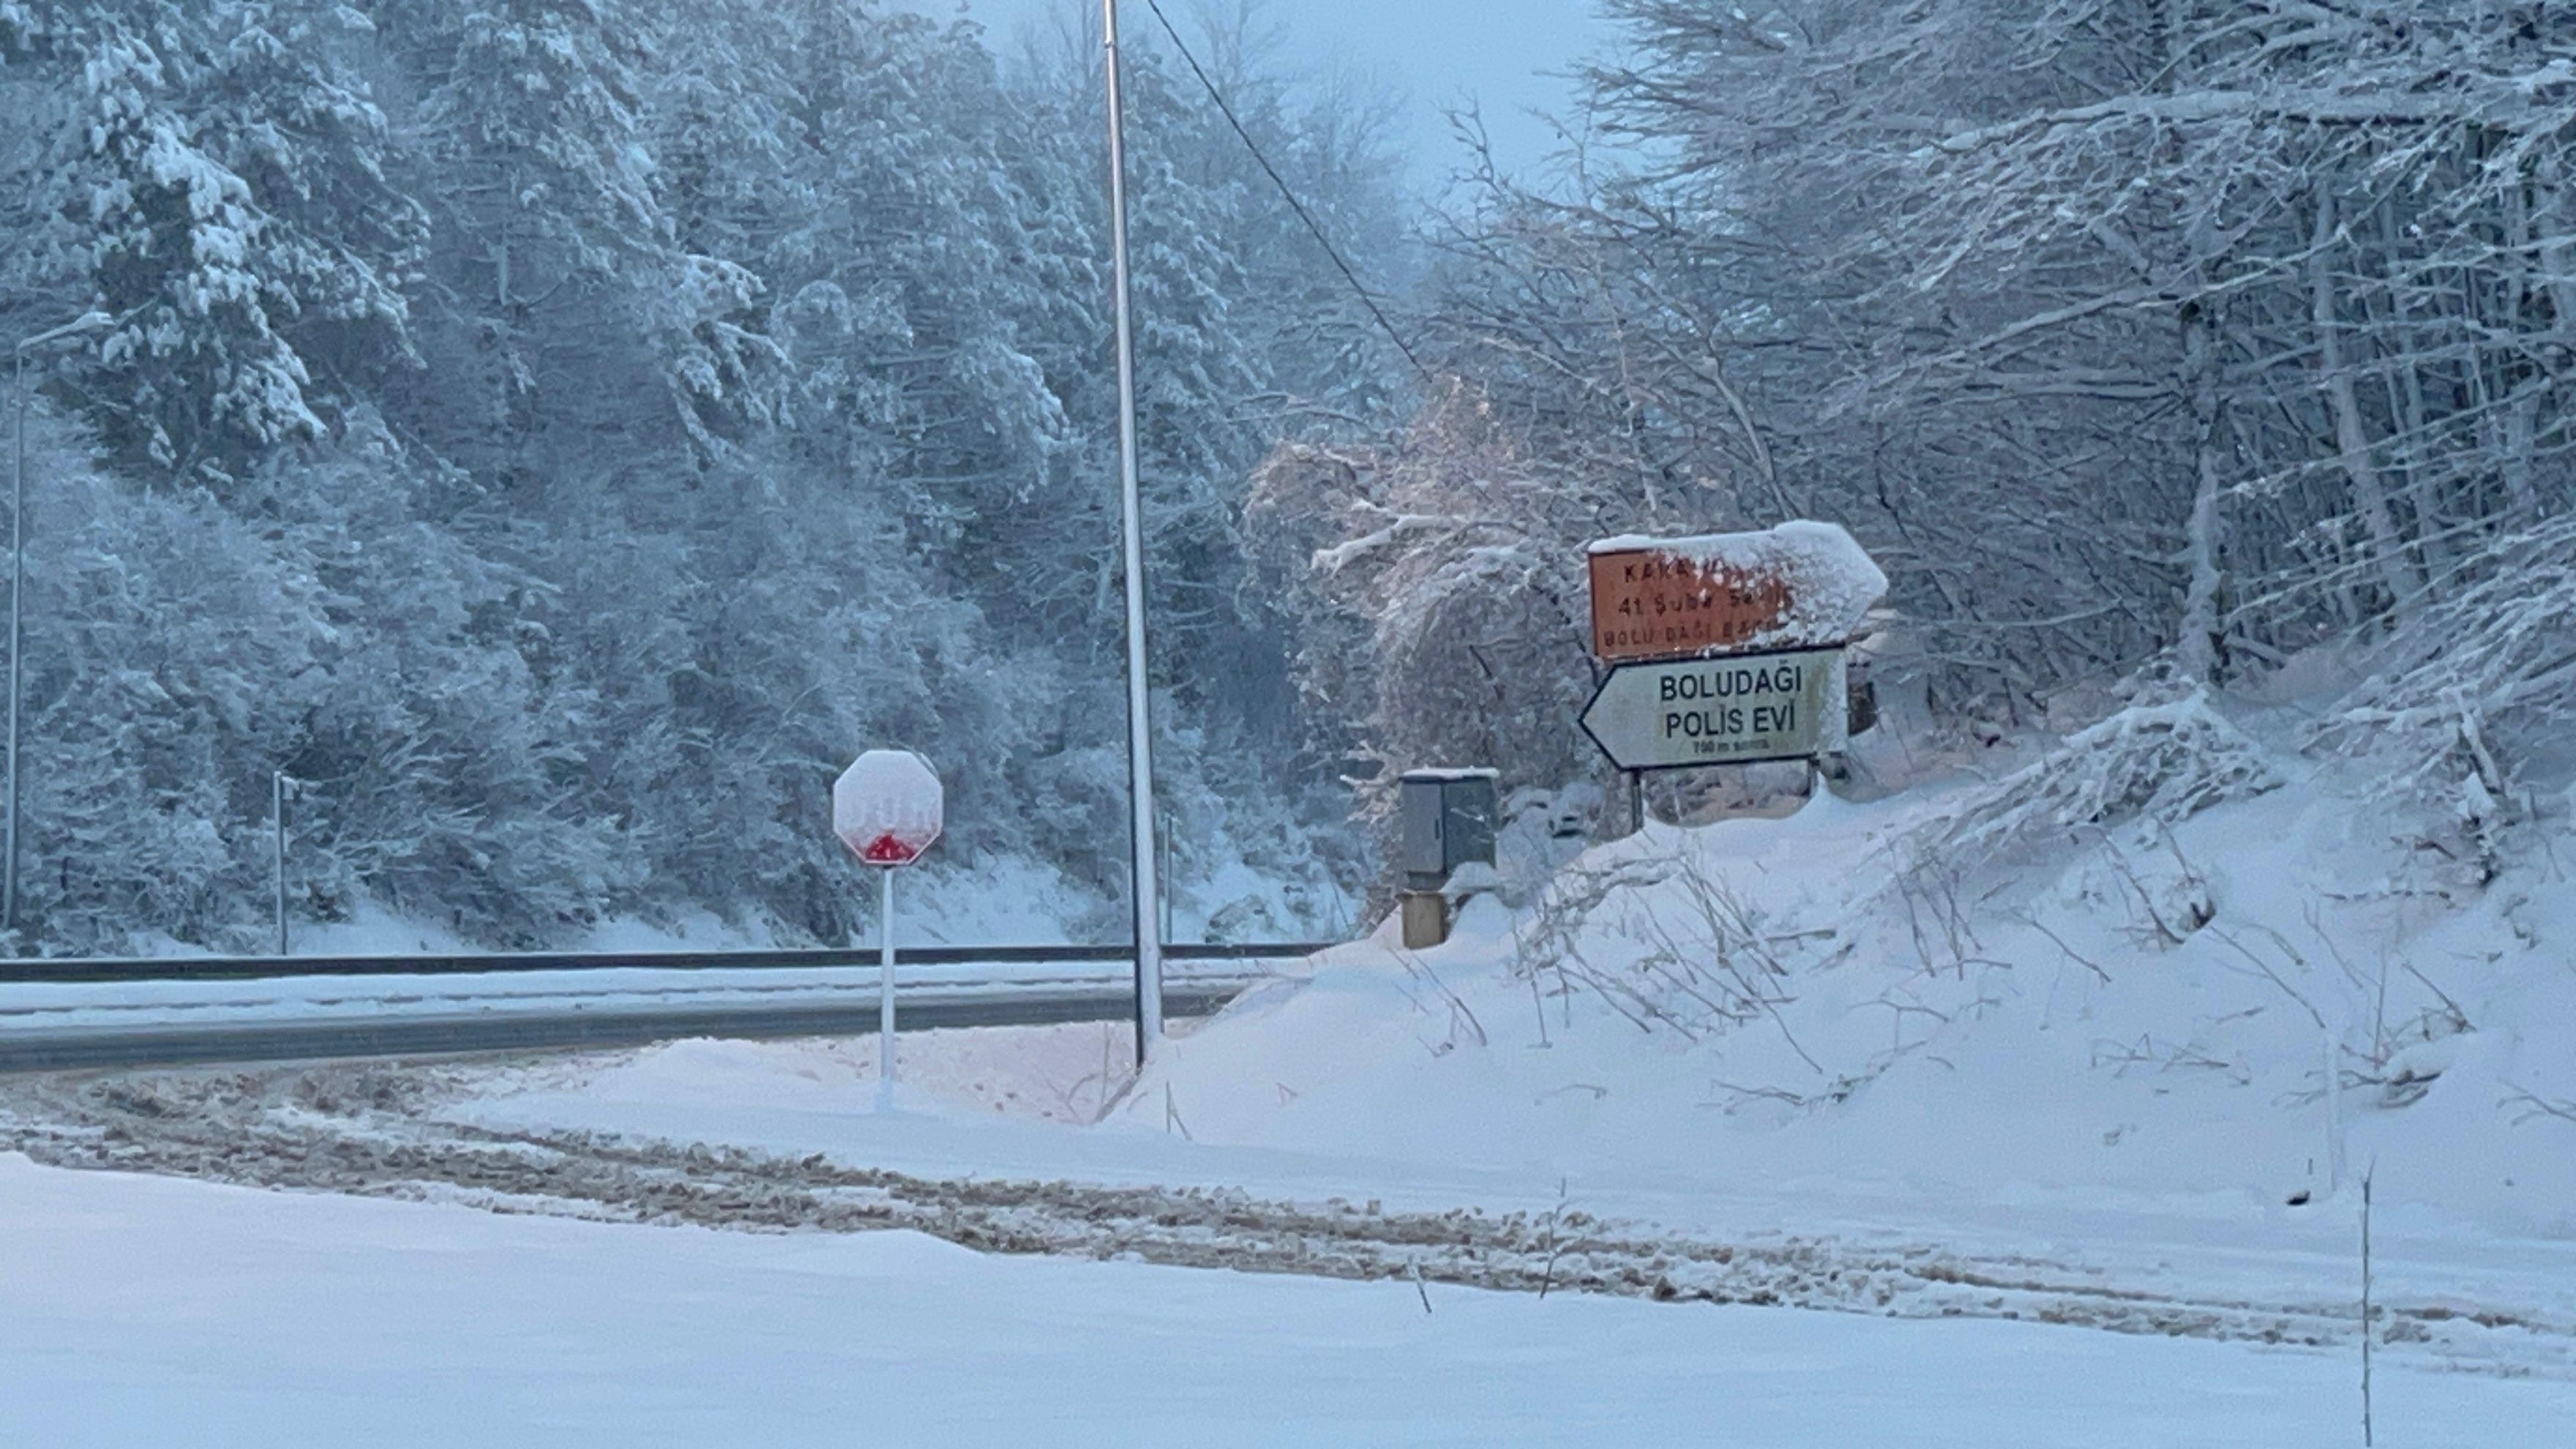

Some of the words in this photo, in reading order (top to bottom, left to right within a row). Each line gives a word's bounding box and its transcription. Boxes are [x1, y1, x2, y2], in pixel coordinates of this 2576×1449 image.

[1603, 628, 1654, 646] BOLU
[1660, 659, 1801, 700] BOLUDAĞI
[1667, 703, 1743, 738] POLİS
[1753, 699, 1794, 733] EVİ
